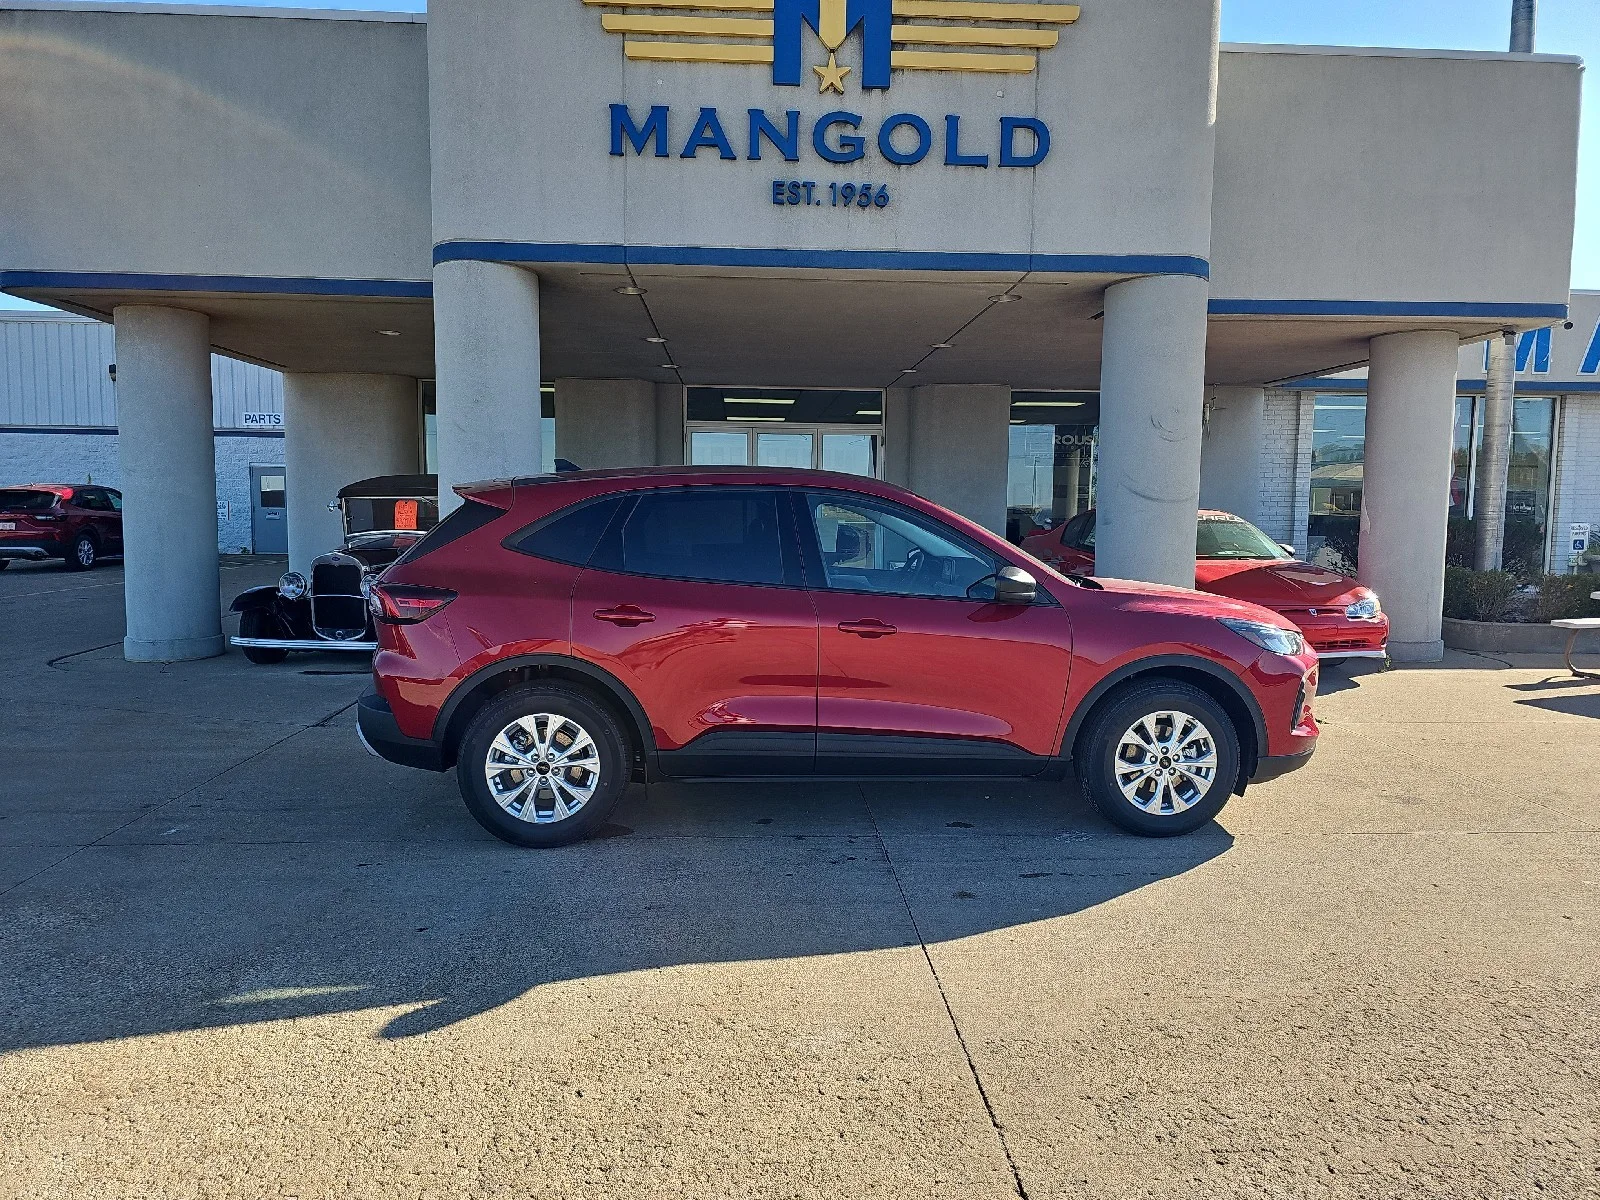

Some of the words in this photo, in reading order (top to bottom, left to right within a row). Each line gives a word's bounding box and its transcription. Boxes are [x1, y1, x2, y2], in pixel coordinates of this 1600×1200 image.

[608, 104, 1051, 168] MANGOLD
[772, 180, 821, 206] EST.
[828, 182, 890, 208] 1956
[244, 413, 281, 424] PARTS
